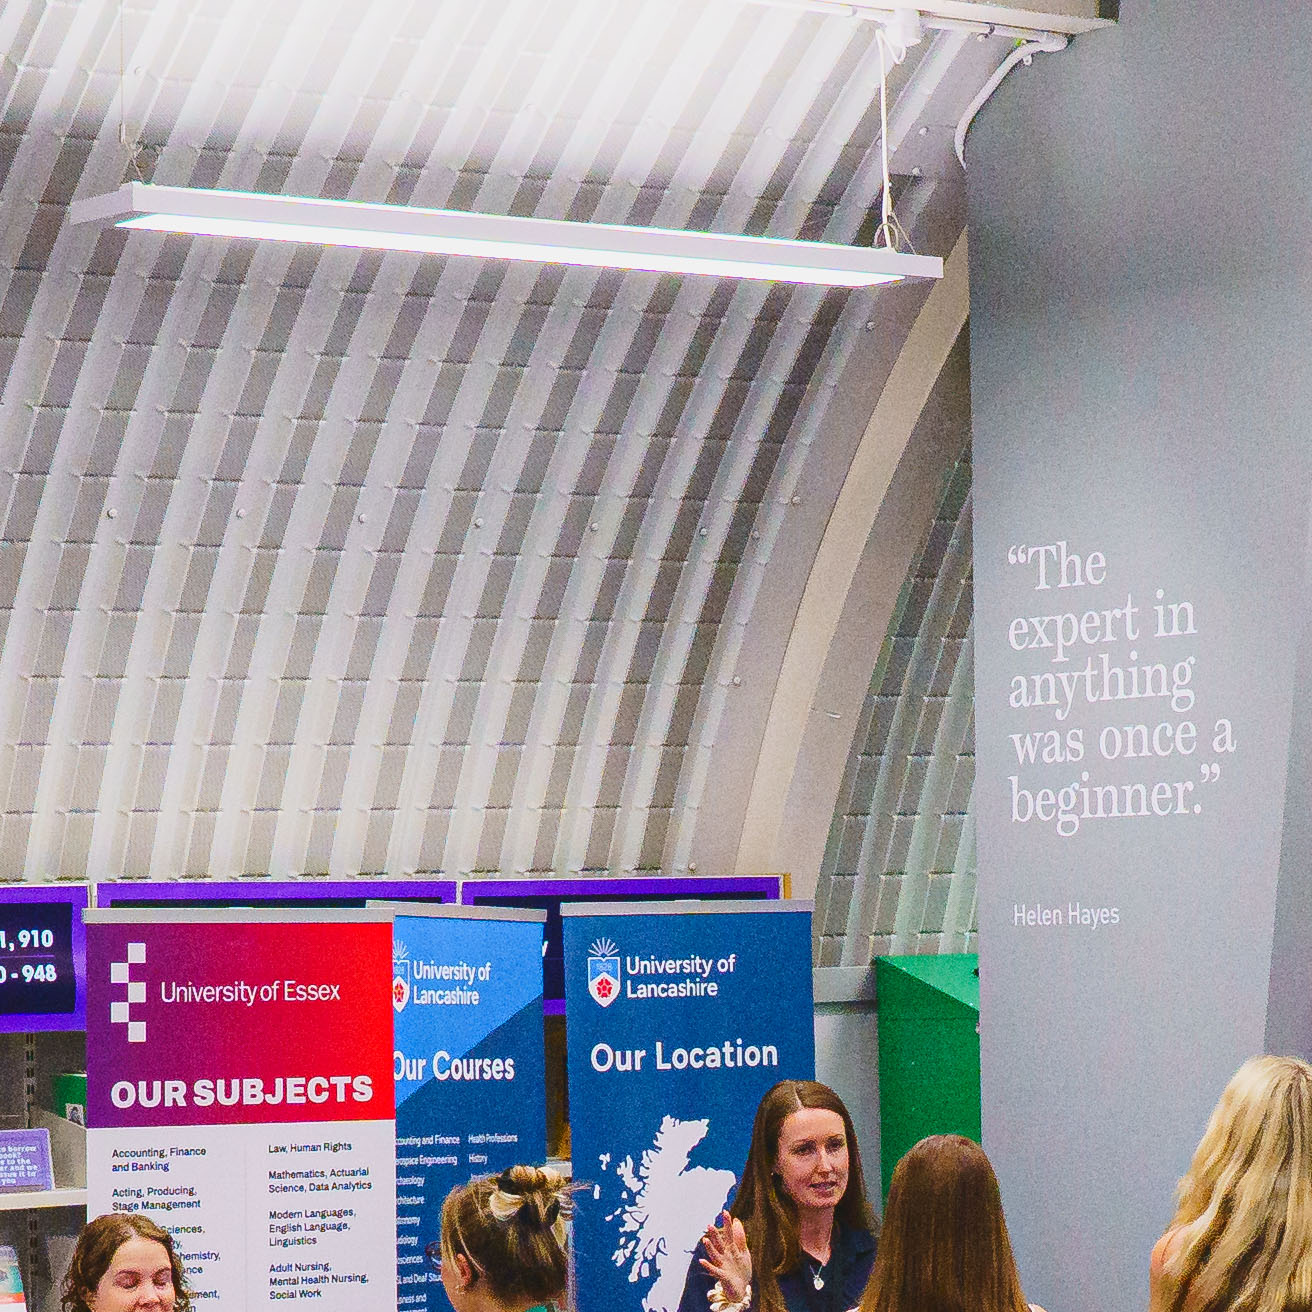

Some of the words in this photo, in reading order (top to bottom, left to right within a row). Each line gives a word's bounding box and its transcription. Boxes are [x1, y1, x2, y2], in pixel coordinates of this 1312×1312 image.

[1007, 541, 1106, 590] “The
[1008, 593, 1139, 663] expert
[1153, 588, 1198, 637] in
[1008, 650, 1196, 721] anything
[1008, 728, 1084, 765] was
[1099, 721, 1197, 759] once
[1212, 718, 1237, 753] a
[1008, 763, 1221, 837] beginner.”
[1013, 903, 1062, 926] Helen
[1068, 902, 1120, 930] Hayes
[18, 929, 54, 948] 910
[22, 963, 56, 982] 948
[413, 961, 475, 985] University
[478, 962, 492, 980] of
[626, 954, 713, 977] University
[717, 953, 736, 973] of
[160, 981, 258, 1007] University
[260, 980, 281, 1002] of
[283, 980, 340, 1002] Essex
[413, 985, 480, 1005] Lancashire
[626, 977, 718, 999] Lancashire
[590, 1042, 646, 1072] Our
[656, 1037, 778, 1070] Location
[393, 1051, 427, 1081] Our
[433, 1050, 515, 1081] Courses
[111, 1080, 188, 1109] OUR
[193, 1075, 374, 1107] SUBJECTS
[112, 1147, 168, 1160] Accounting,
[169, 1147, 206, 1157] Finance
[268, 1144, 288, 1154] Law,
[290, 1143, 321, 1153] Human
[323, 1142, 352, 1153] Rights
[112, 1162, 129, 1172] and
[132, 1161, 170, 1173] Banking
[269, 1168, 328, 1180] Mathematics,
[329, 1167, 370, 1178] Actuarial
[112, 1187, 145, 1198] Acting,
[147, 1186, 198, 1198] Producing,
[269, 1183, 307, 1194] Science,
[309, 1182, 329, 1192] Data
[331, 1181, 372, 1193] Analytics
[112, 1202, 140, 1213] Stage
[141, 1200, 201, 1212] Management
[269, 1210, 302, 1220] Modern
[305, 1208, 356, 1221] Languages,
[269, 1223, 302, 1234] English
[305, 1222, 350, 1233] Language,
[269, 1236, 317, 1247] Linguistics
